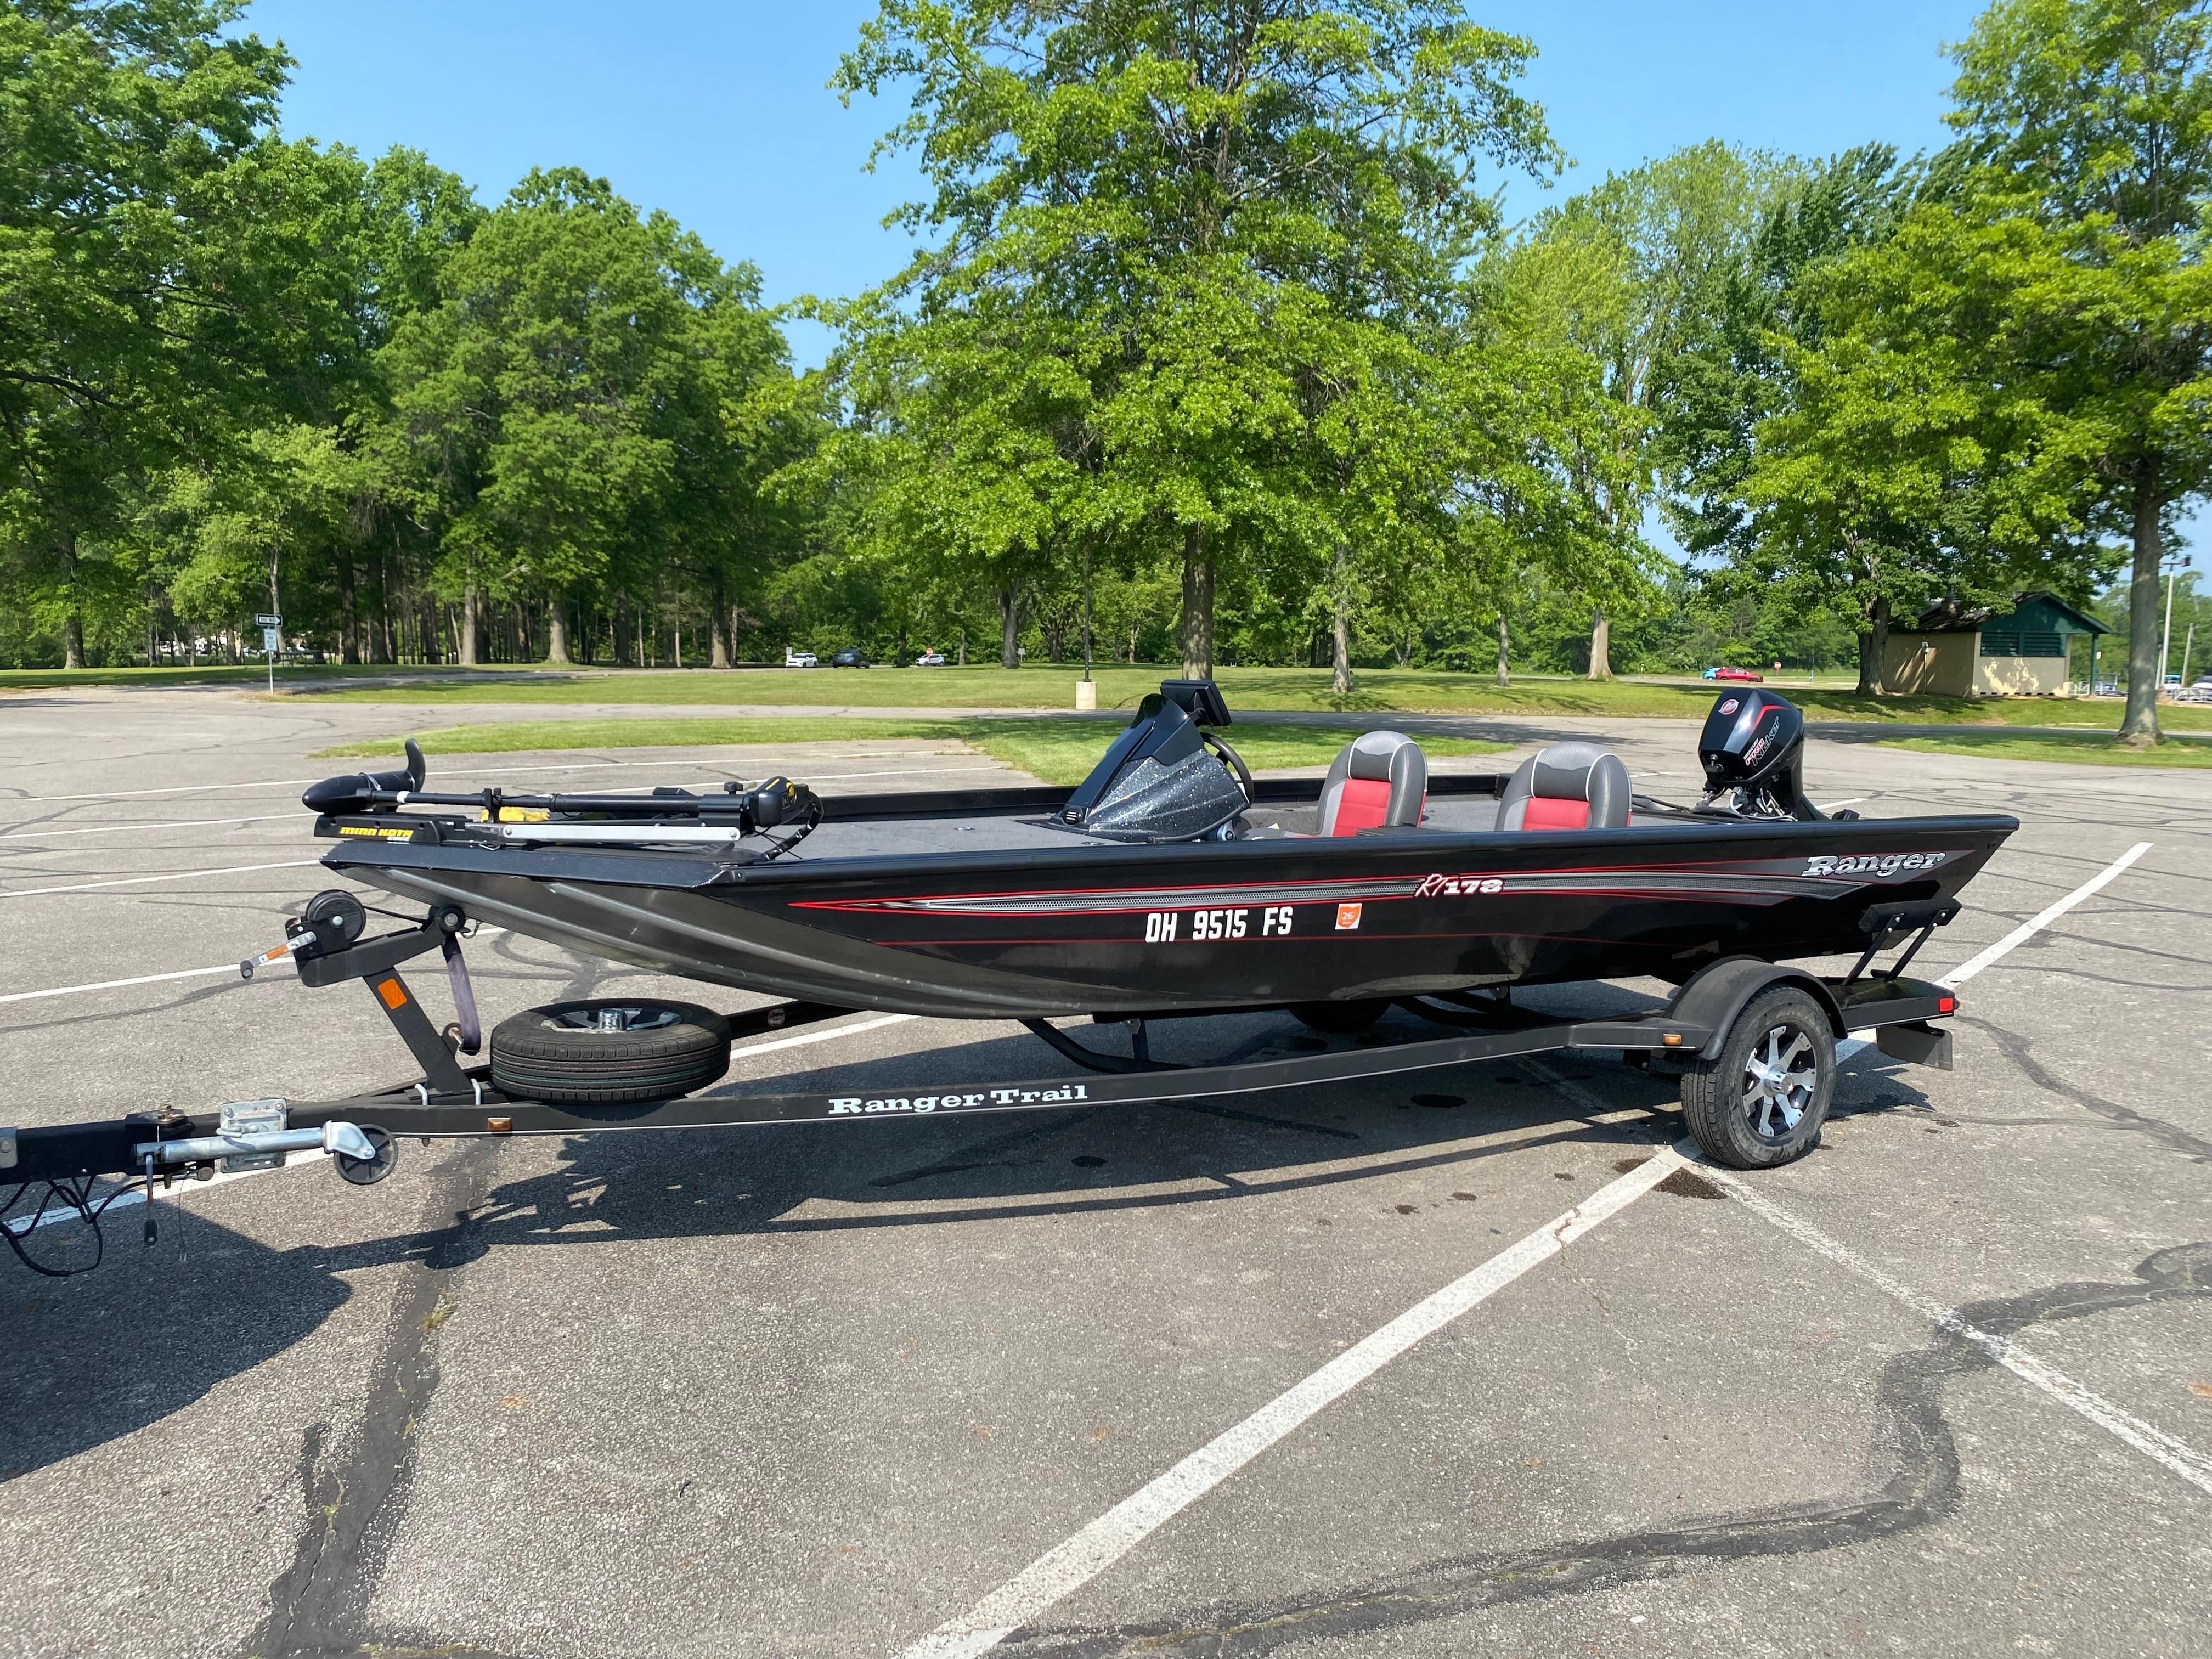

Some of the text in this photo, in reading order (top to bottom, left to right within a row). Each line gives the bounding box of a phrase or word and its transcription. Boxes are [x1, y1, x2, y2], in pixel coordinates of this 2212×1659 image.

[1801, 852, 1946, 877] Ranger
[1145, 906, 1293, 943] OH 9515 FS
[1342, 911, 1355, 921] 26
[828, 1085, 1088, 1113] Ranger Trail
